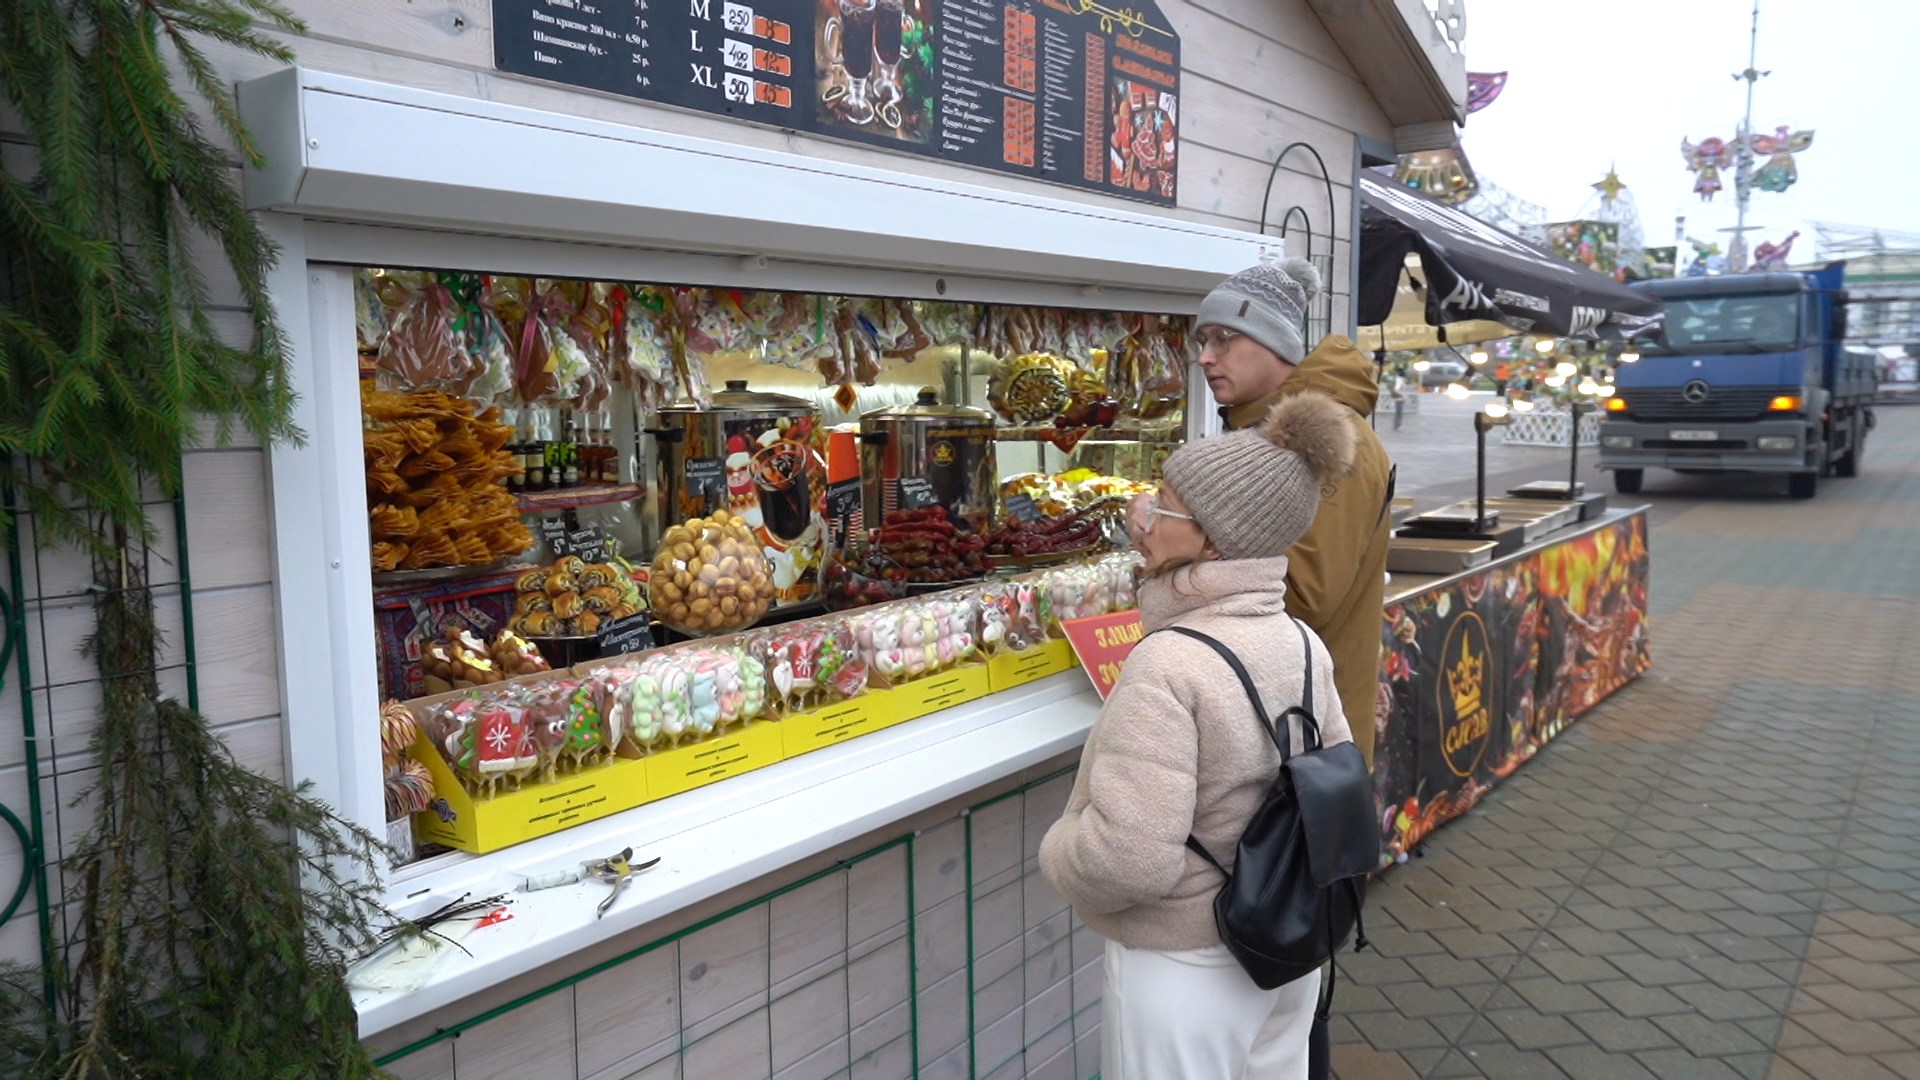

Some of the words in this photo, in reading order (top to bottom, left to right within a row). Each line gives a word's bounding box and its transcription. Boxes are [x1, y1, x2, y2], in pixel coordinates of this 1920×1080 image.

[690, 0, 710, 20] M
[729, 9, 749, 26] 250
[590, 24, 604, 35] 200
[690, 29, 703, 52] L
[728, 43, 749, 61] 400
[691, 63, 717, 88] XL
